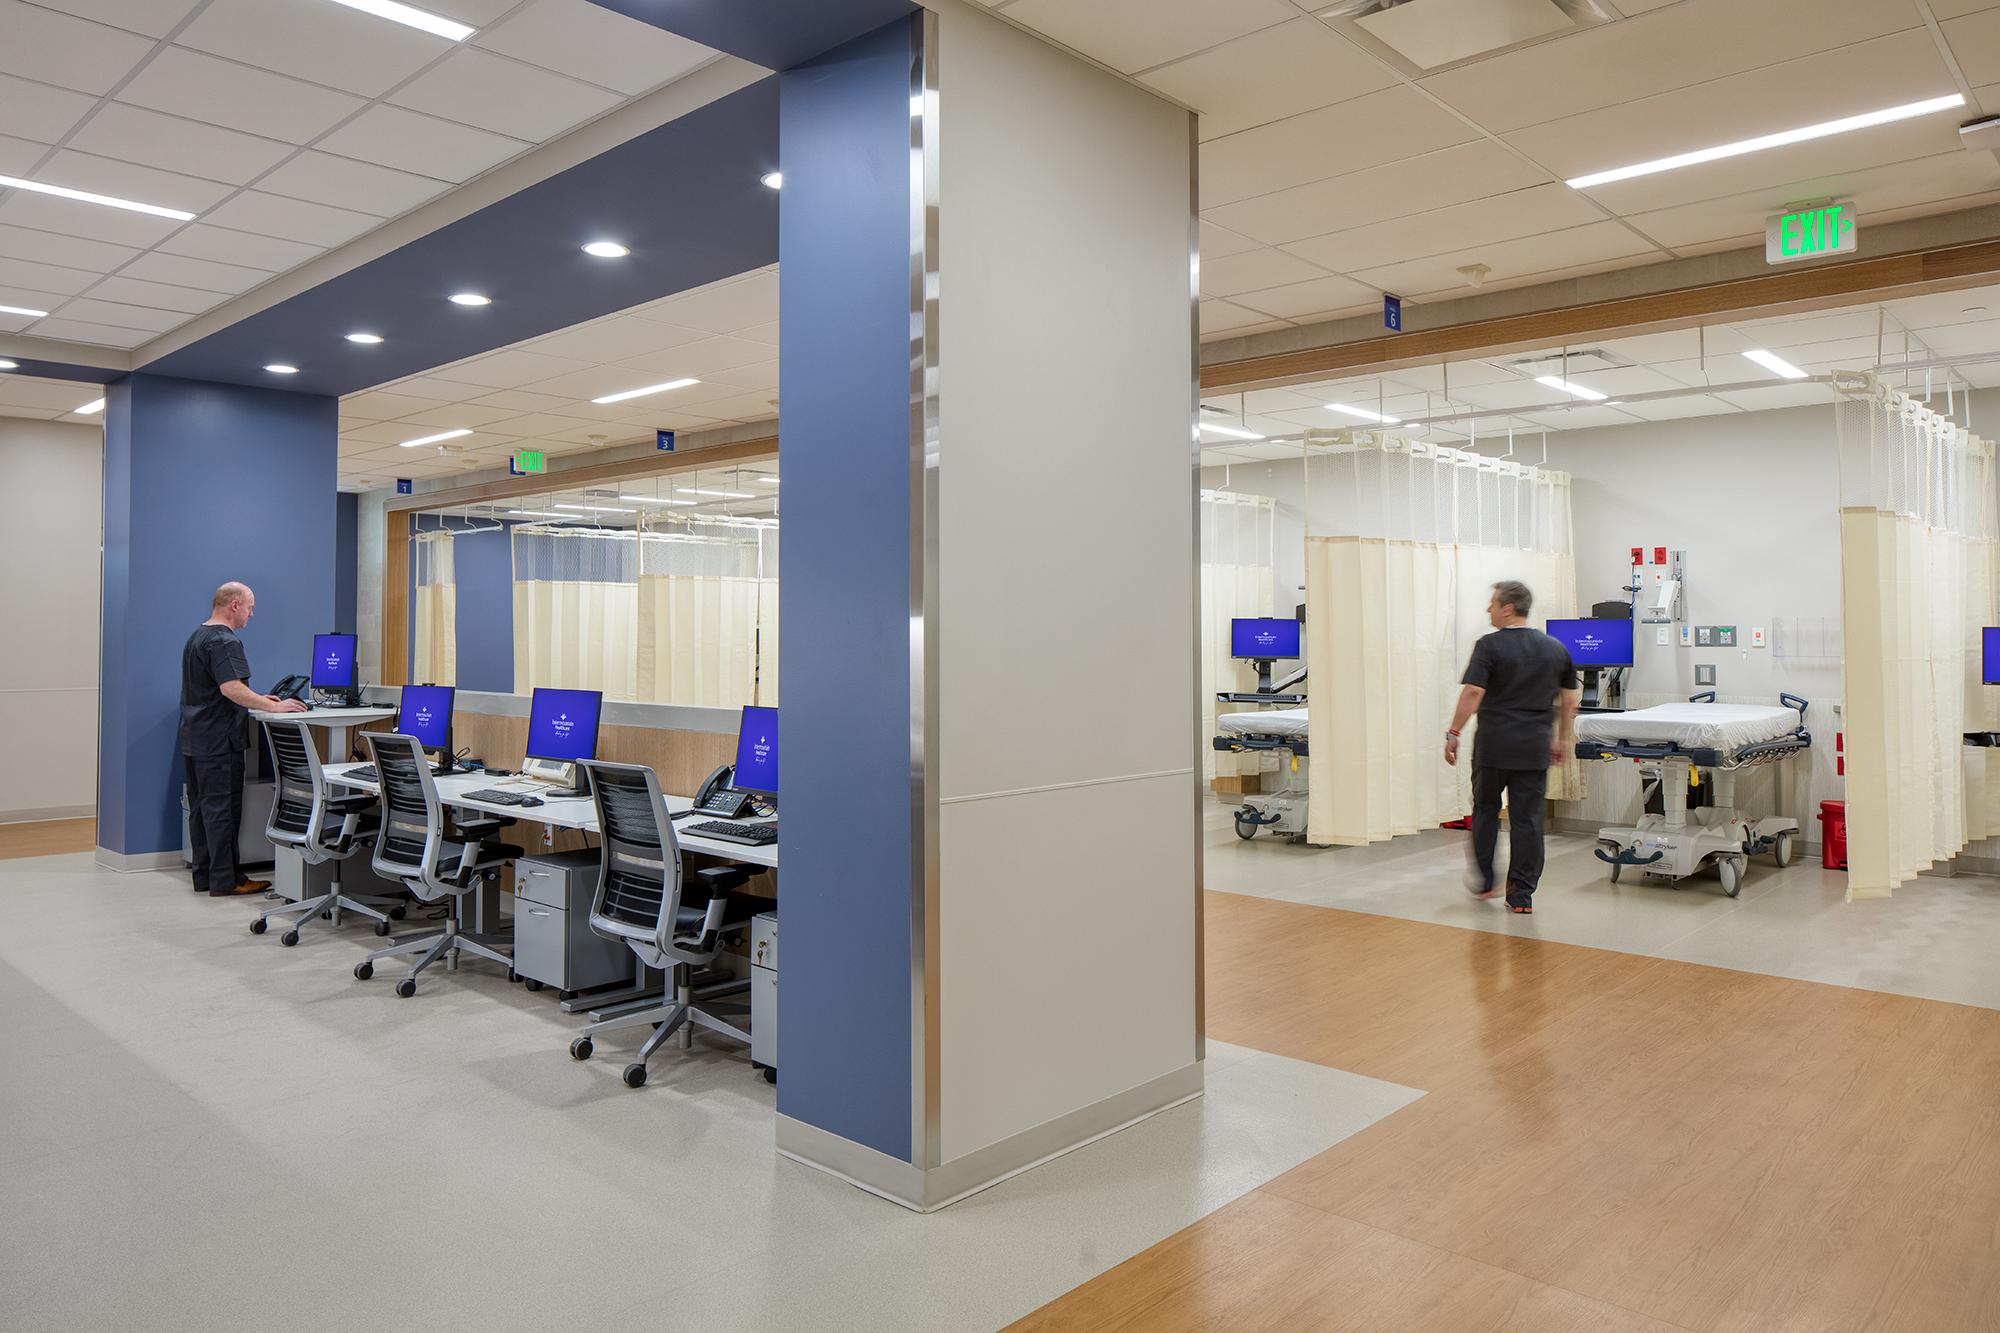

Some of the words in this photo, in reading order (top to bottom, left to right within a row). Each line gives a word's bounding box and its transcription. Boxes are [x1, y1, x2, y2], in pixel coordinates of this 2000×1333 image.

[1781, 206, 1843, 256] EXIT
[1390, 312, 1396, 327] 6
[662, 439, 669, 449] 3
[521, 451, 545, 472] EXIT
